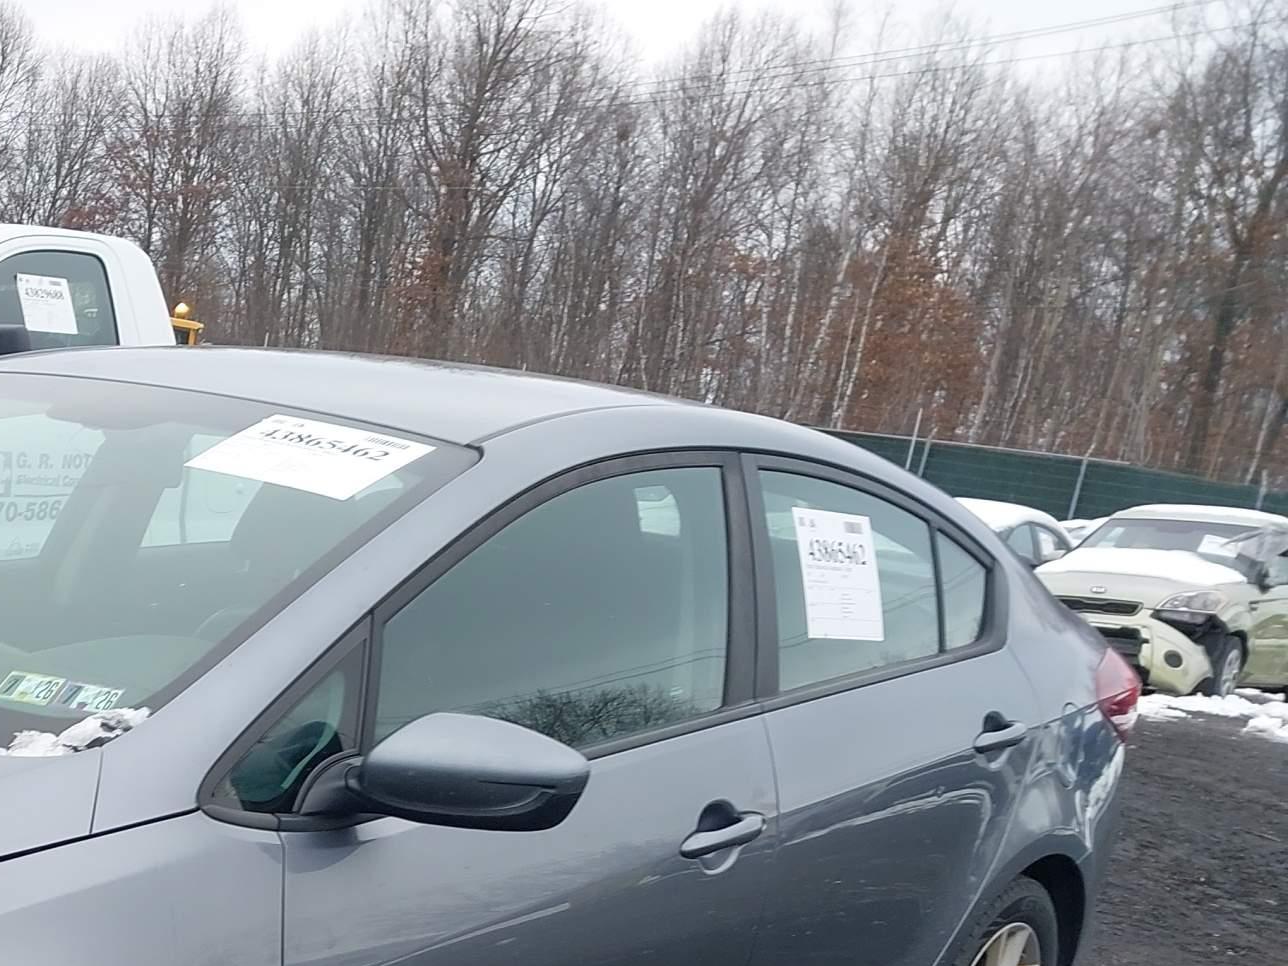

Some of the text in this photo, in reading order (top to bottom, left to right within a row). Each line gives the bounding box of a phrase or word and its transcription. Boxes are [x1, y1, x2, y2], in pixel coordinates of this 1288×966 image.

[261, 428, 390, 462] 43865462
[16, 452, 32, 469] G.
[38, 453, 54, 469] R.
[809, 538, 867, 565] 43865462
